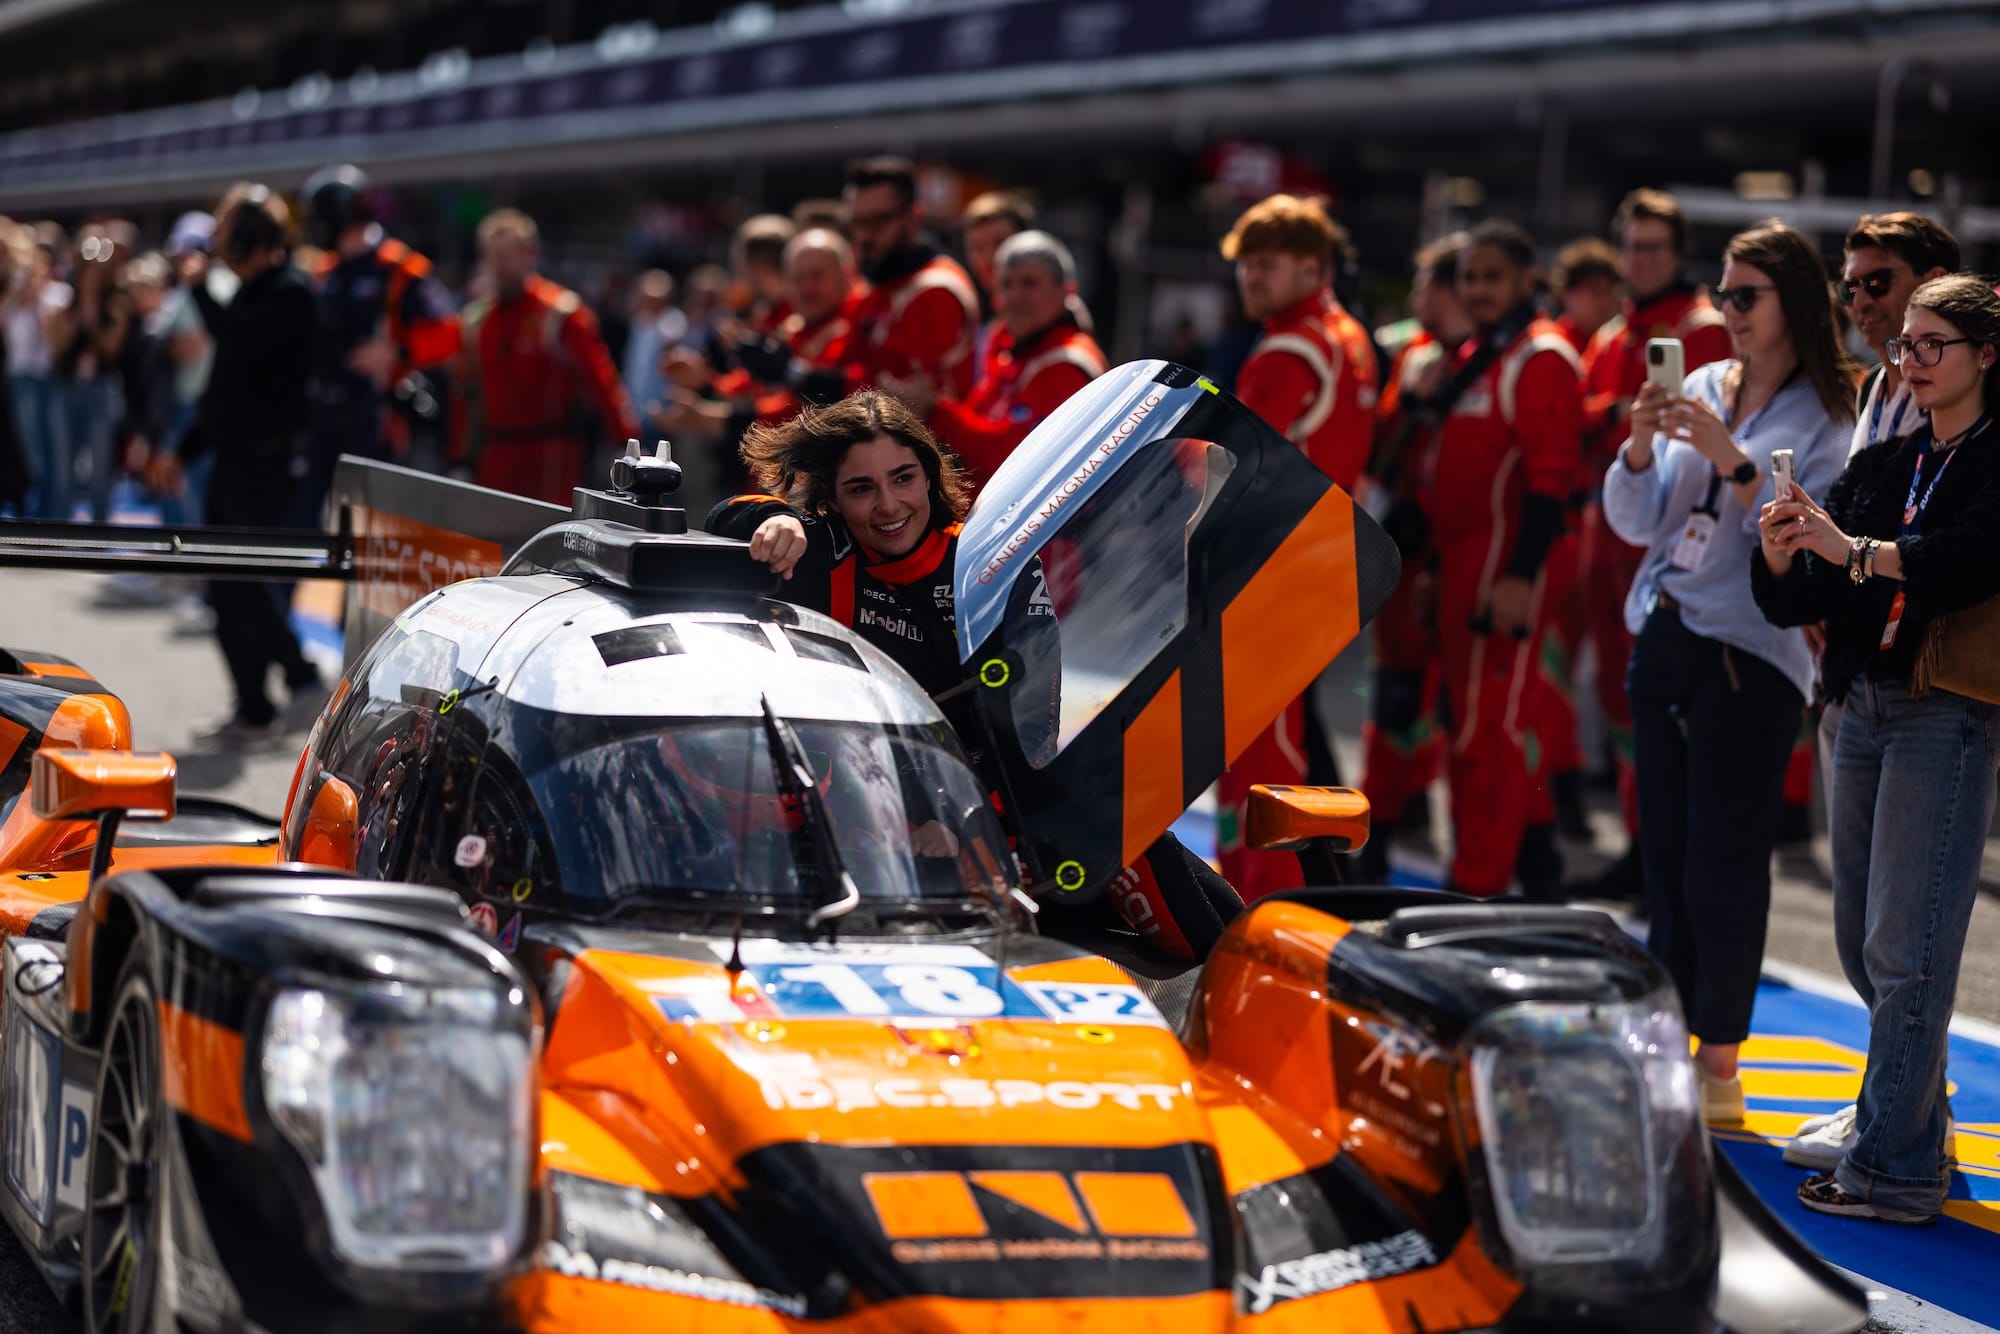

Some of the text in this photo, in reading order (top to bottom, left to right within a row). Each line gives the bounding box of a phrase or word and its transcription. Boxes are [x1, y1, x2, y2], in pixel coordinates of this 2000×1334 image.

[1165, 366, 1184, 384] PULL
[977, 393, 1161, 586] GENESIS MAGMA RACING
[860, 607, 907, 637] Mobil
[780, 962, 1004, 1017] 18
